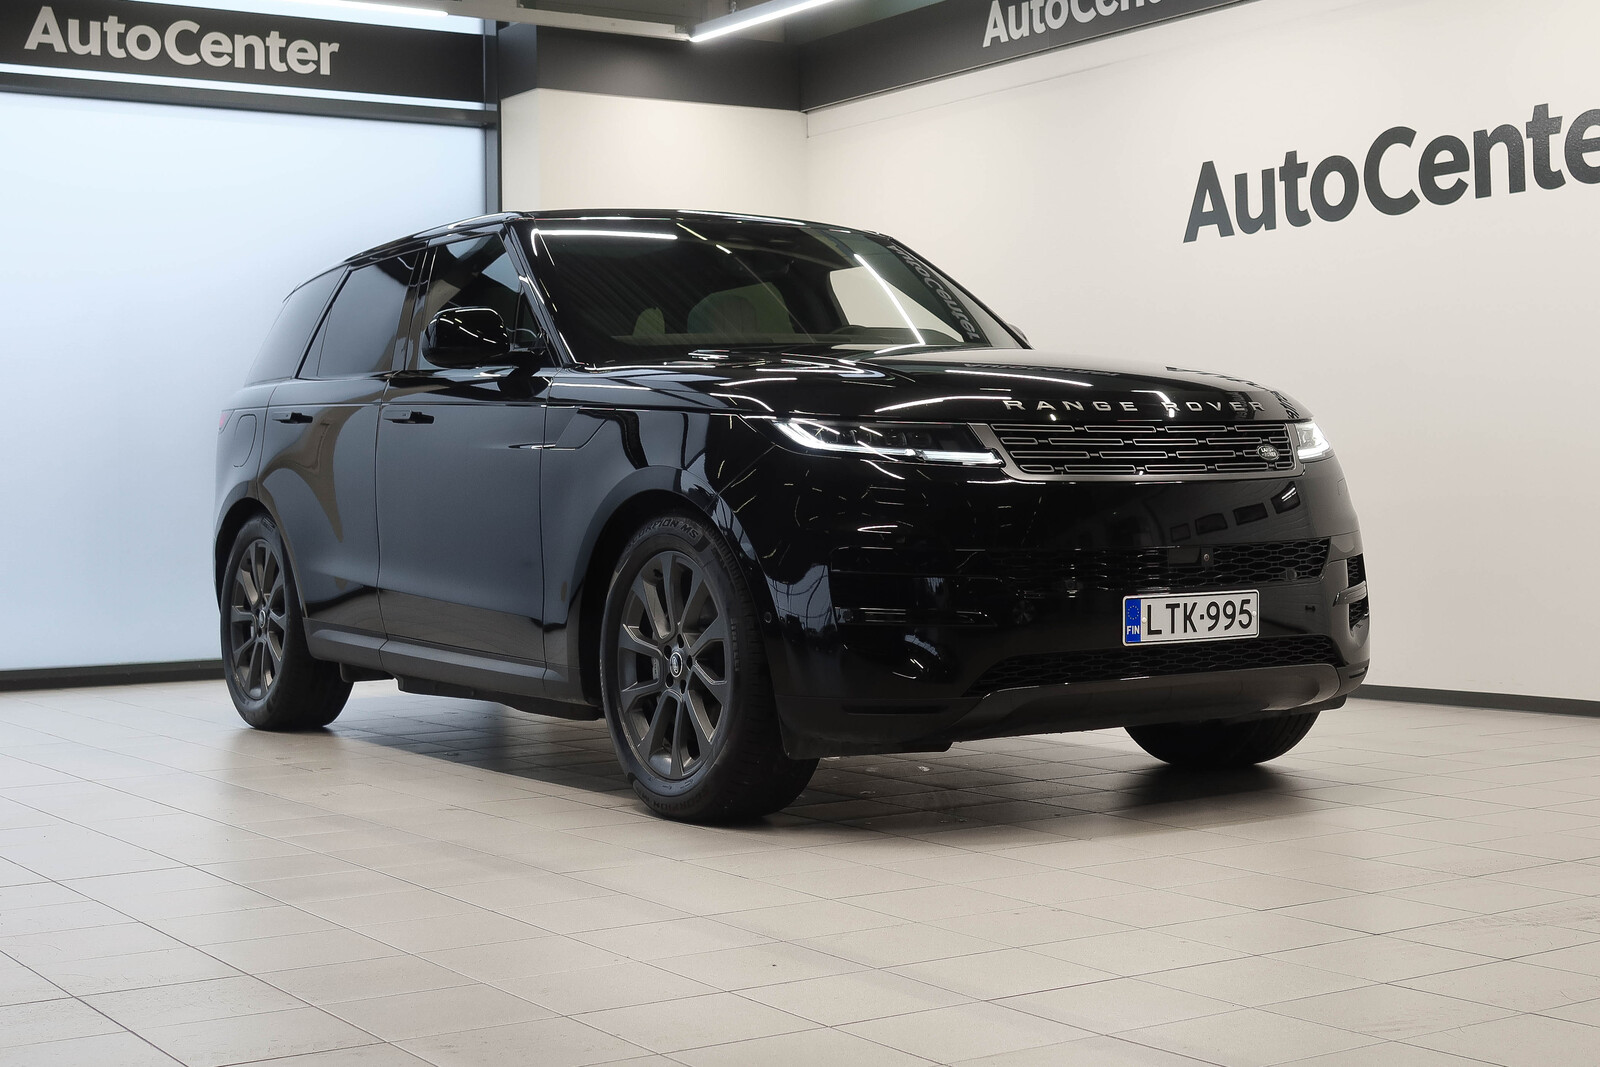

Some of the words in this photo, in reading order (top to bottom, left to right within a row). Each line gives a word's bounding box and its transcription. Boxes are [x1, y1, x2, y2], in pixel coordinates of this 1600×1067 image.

[24, 6, 340, 76] AutoCenter
[1002, 400, 1138, 412] RANGE
[1161, 401, 1265, 412] ROVER
[681, 523, 699, 539] MS
[1147, 599, 1253, 635] LTK-995
[1126, 625, 1140, 635] FIN
